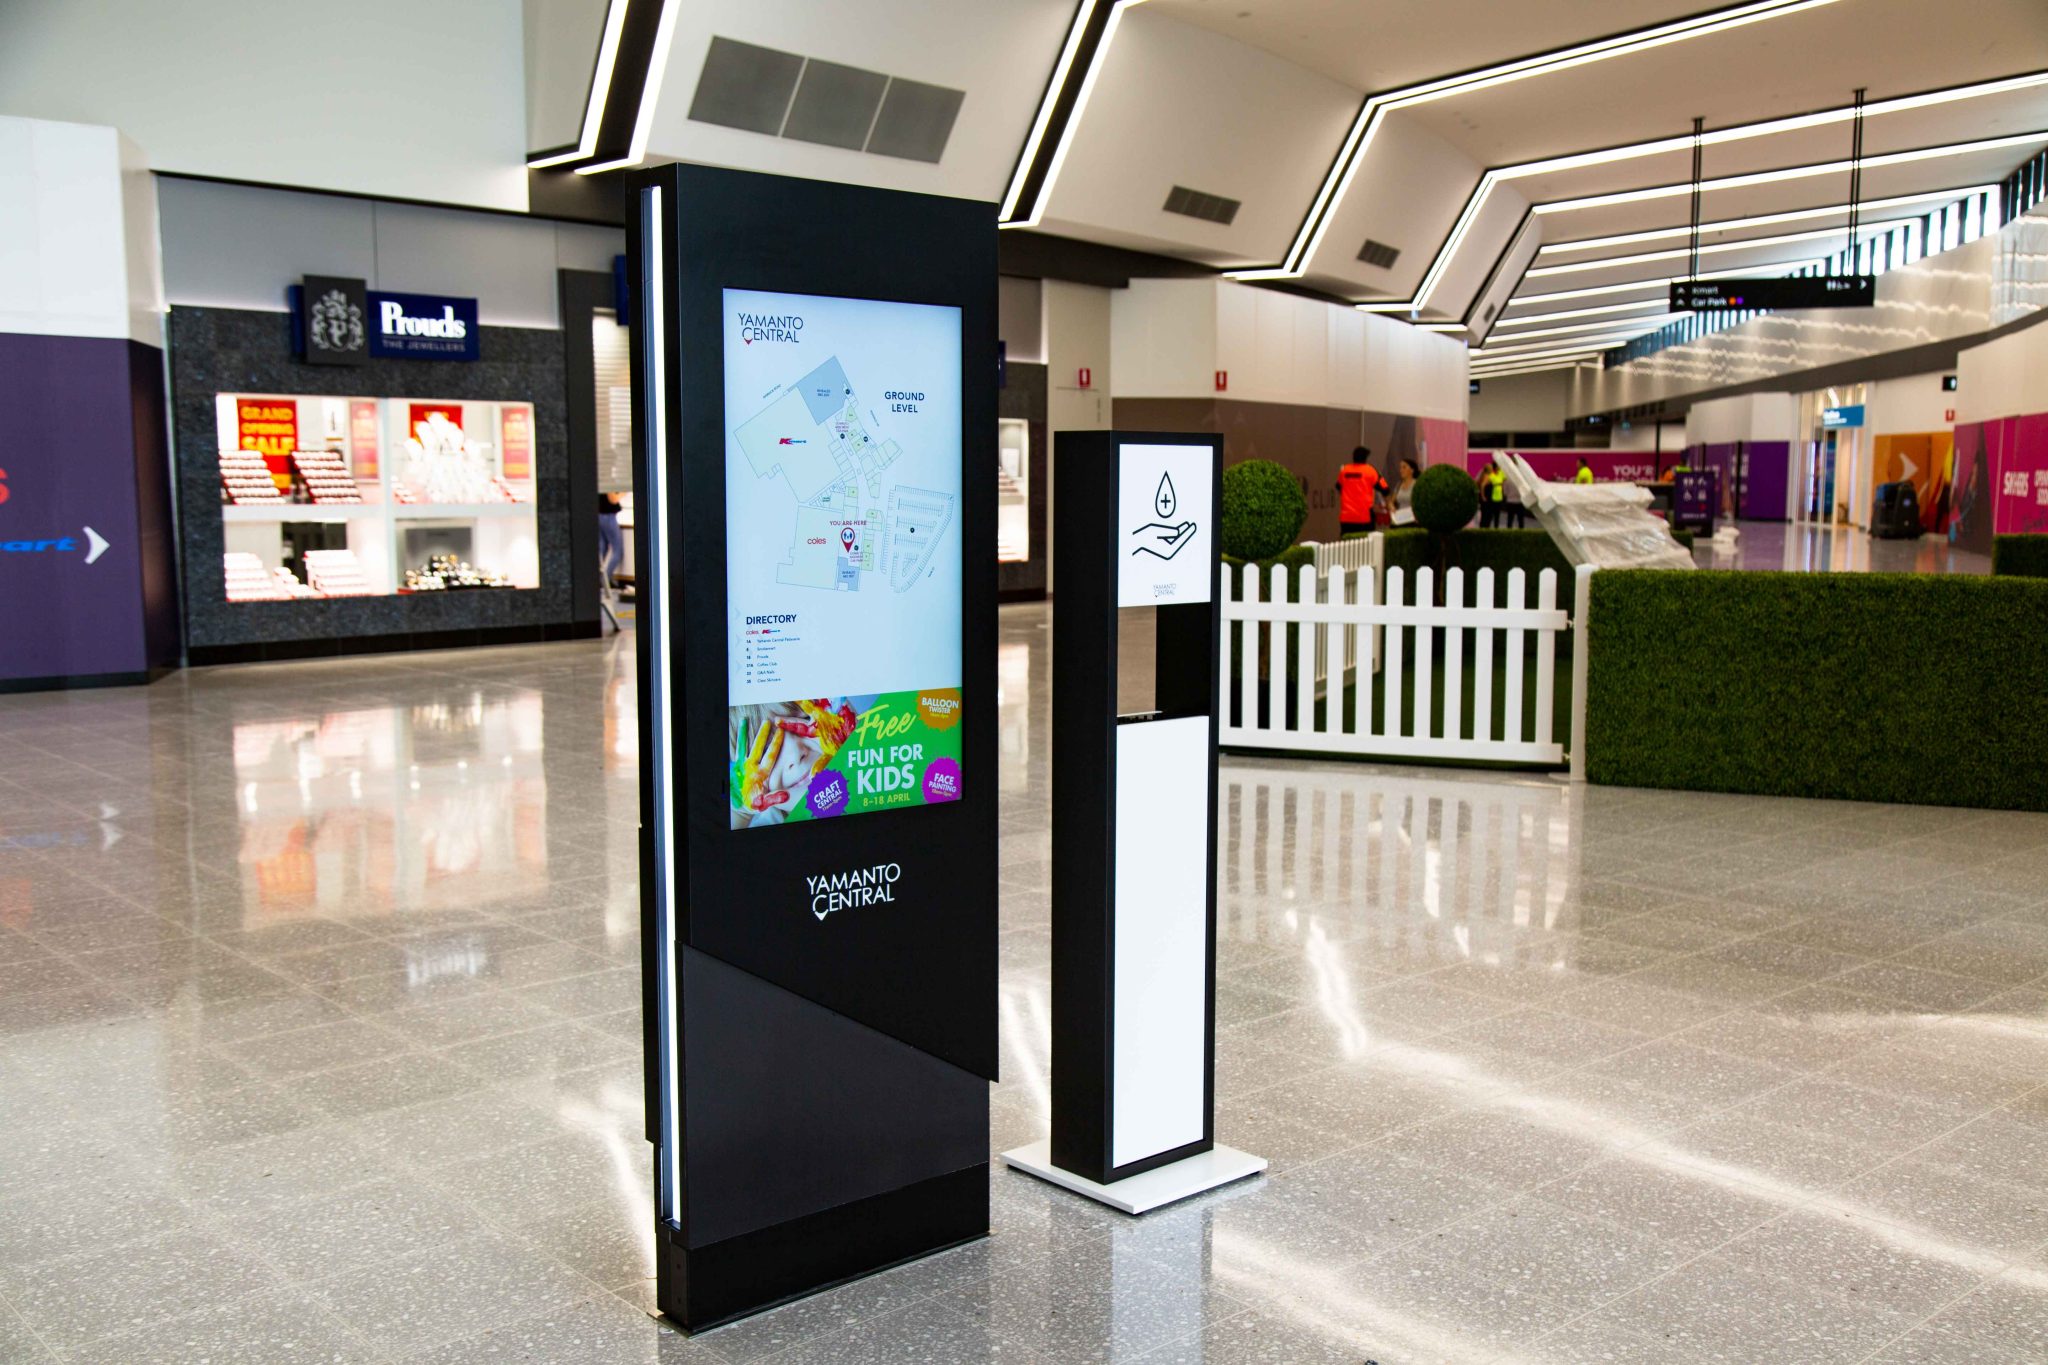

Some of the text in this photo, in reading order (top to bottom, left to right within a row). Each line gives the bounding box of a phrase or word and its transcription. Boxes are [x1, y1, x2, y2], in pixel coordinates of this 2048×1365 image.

[1691, 296, 1728, 307] Car Park
[380, 300, 466, 339] Prouds
[738, 312, 804, 330] YAMANTO
[742, 326, 800, 344] CENTRAL
[382, 340, 466, 352] THE JEWELLERS
[884, 391, 925, 402] GROUND
[240, 406, 293, 421] GRAND
[891, 403, 918, 414] LEVEL
[240, 422, 295, 435] OPENING
[241, 435, 296, 456] SALE
[806, 537, 827, 545] coles
[746, 614, 797, 625] DIRECTORY
[921, 697, 960, 709] BALLOON
[929, 706, 951, 714] TWISTER
[855, 703, 917, 747] Free
[848, 744, 923, 768] FUN FOR
[857, 763, 915, 795] KIDS
[934, 772, 955, 786] FACE
[814, 779, 840, 804] CRAFT
[928, 780, 957, 793] PAINTING
[817, 788, 843, 809] CENTRAL
[887, 792, 911, 805] APRIL
[806, 862, 901, 895] YAMANTO
[812, 883, 896, 917] CENTRAL
